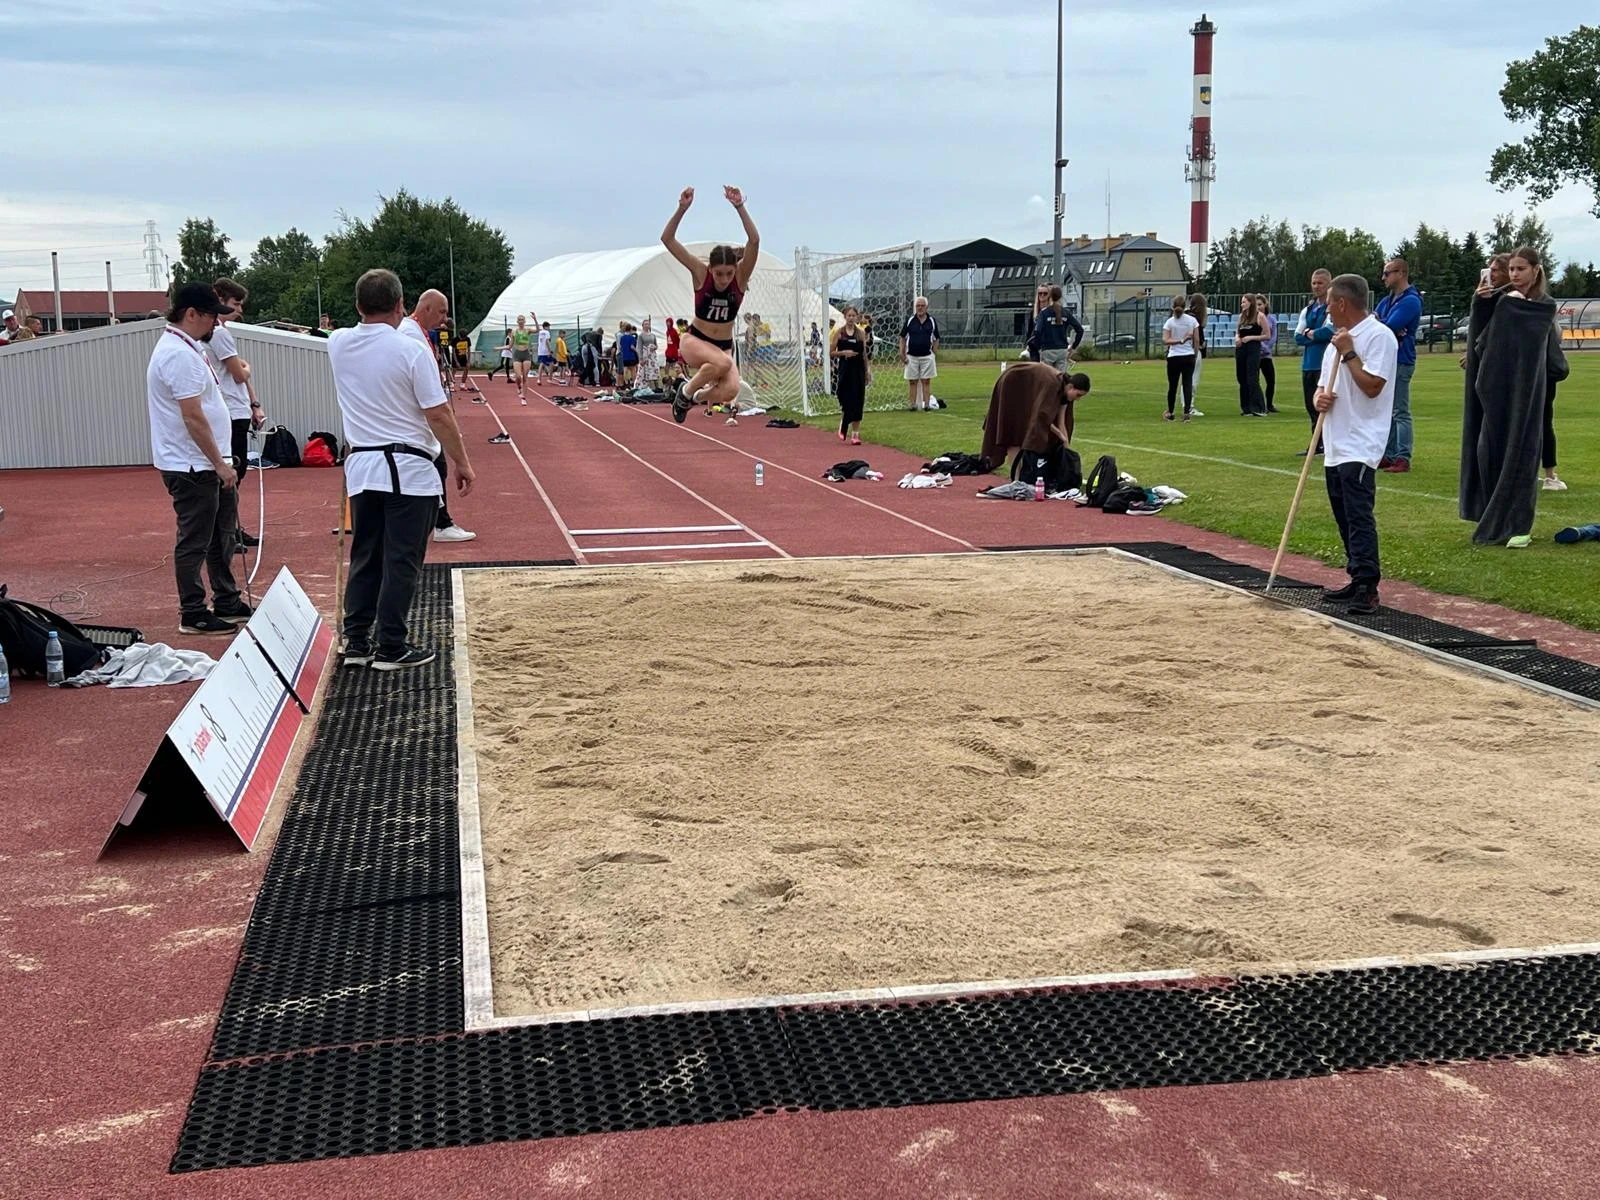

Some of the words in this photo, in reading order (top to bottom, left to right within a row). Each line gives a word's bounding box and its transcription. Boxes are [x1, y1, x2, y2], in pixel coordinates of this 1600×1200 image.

[706, 305, 729, 321] 714
[264, 611, 285, 641] 6
[234, 651, 258, 687] 7
[200, 703, 227, 742] 8
